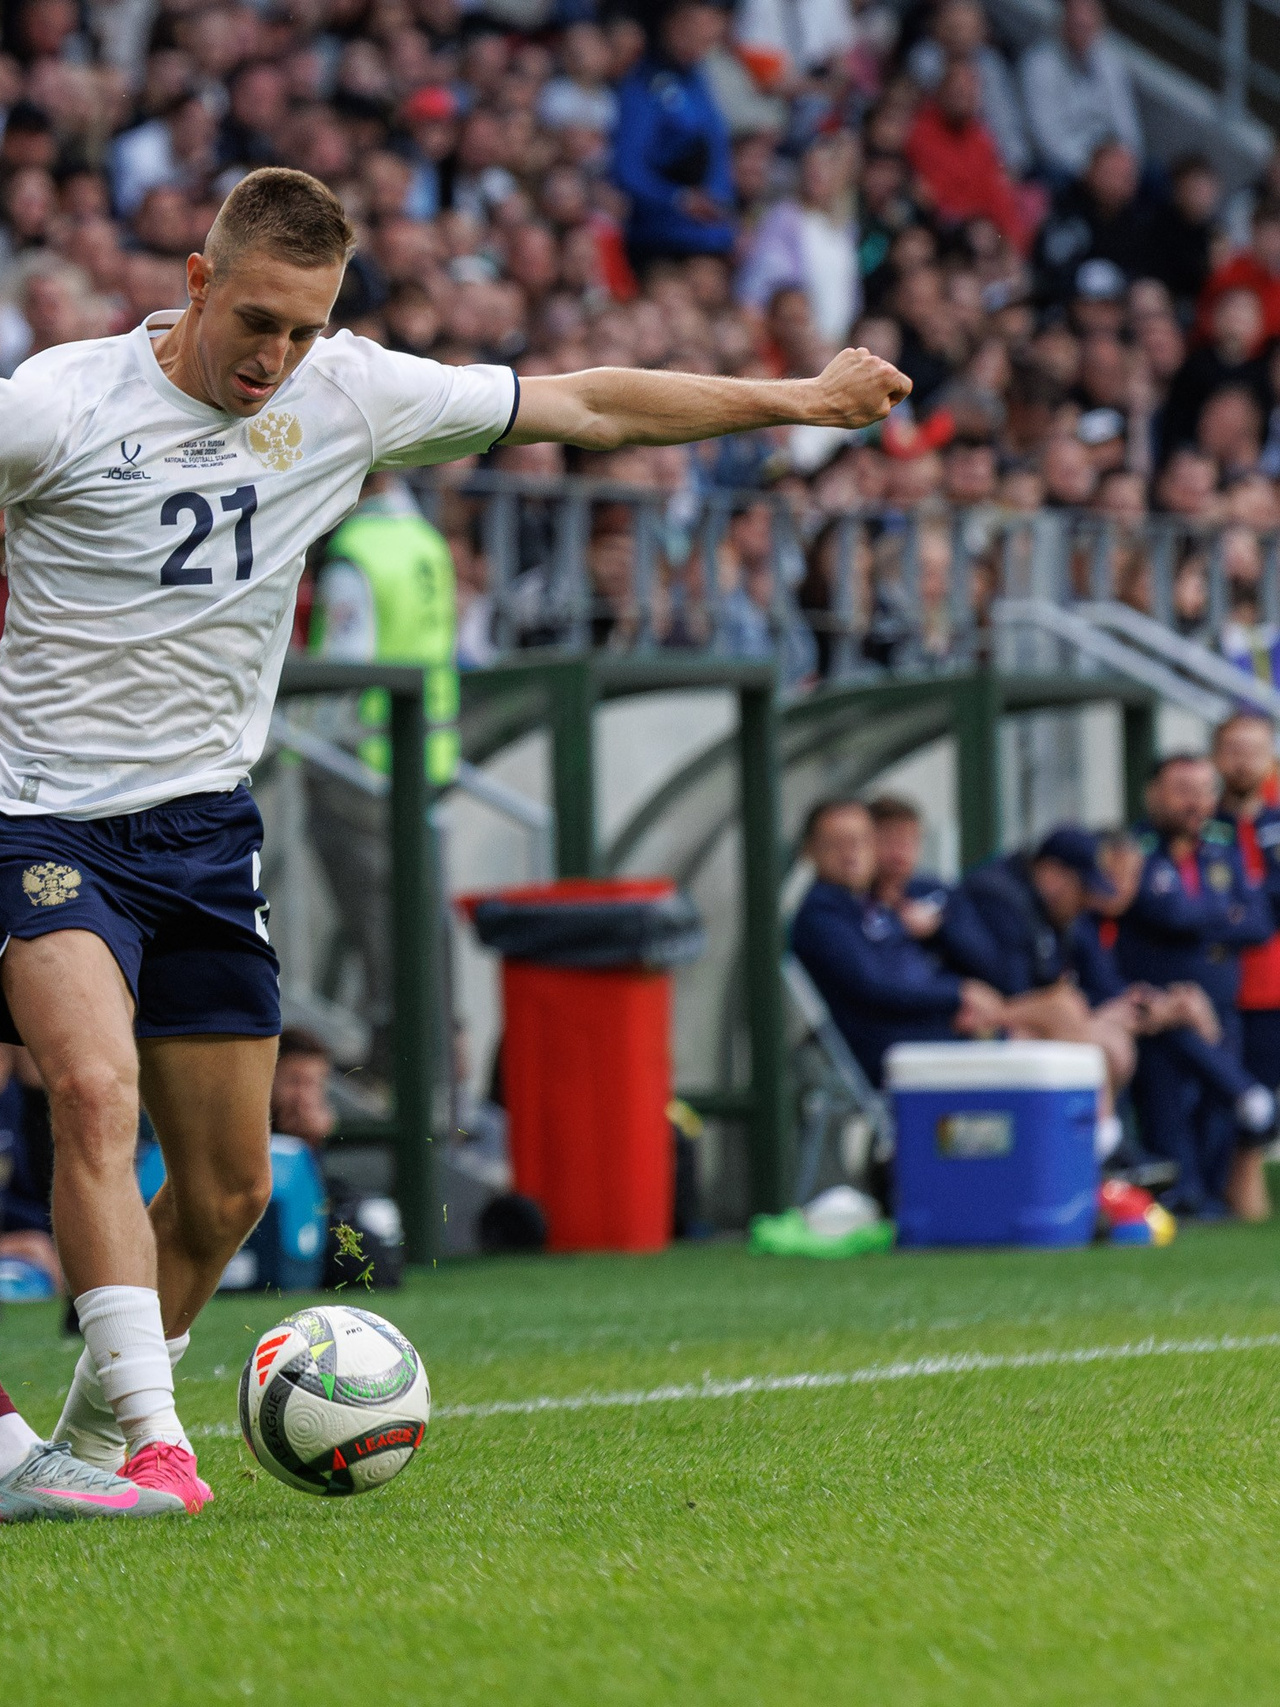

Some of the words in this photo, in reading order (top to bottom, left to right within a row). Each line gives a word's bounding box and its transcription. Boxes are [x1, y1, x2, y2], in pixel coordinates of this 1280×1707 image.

[190, 448, 204, 456] JUNE
[215, 453, 237, 461] STADIUM
[101, 467, 151, 480] JÖGEL
[160, 484, 258, 586] 21
[346, 1327, 363, 1336] PRO
[265, 1391, 290, 1460] LEAGUE
[355, 1427, 414, 1456] LEAGUE
